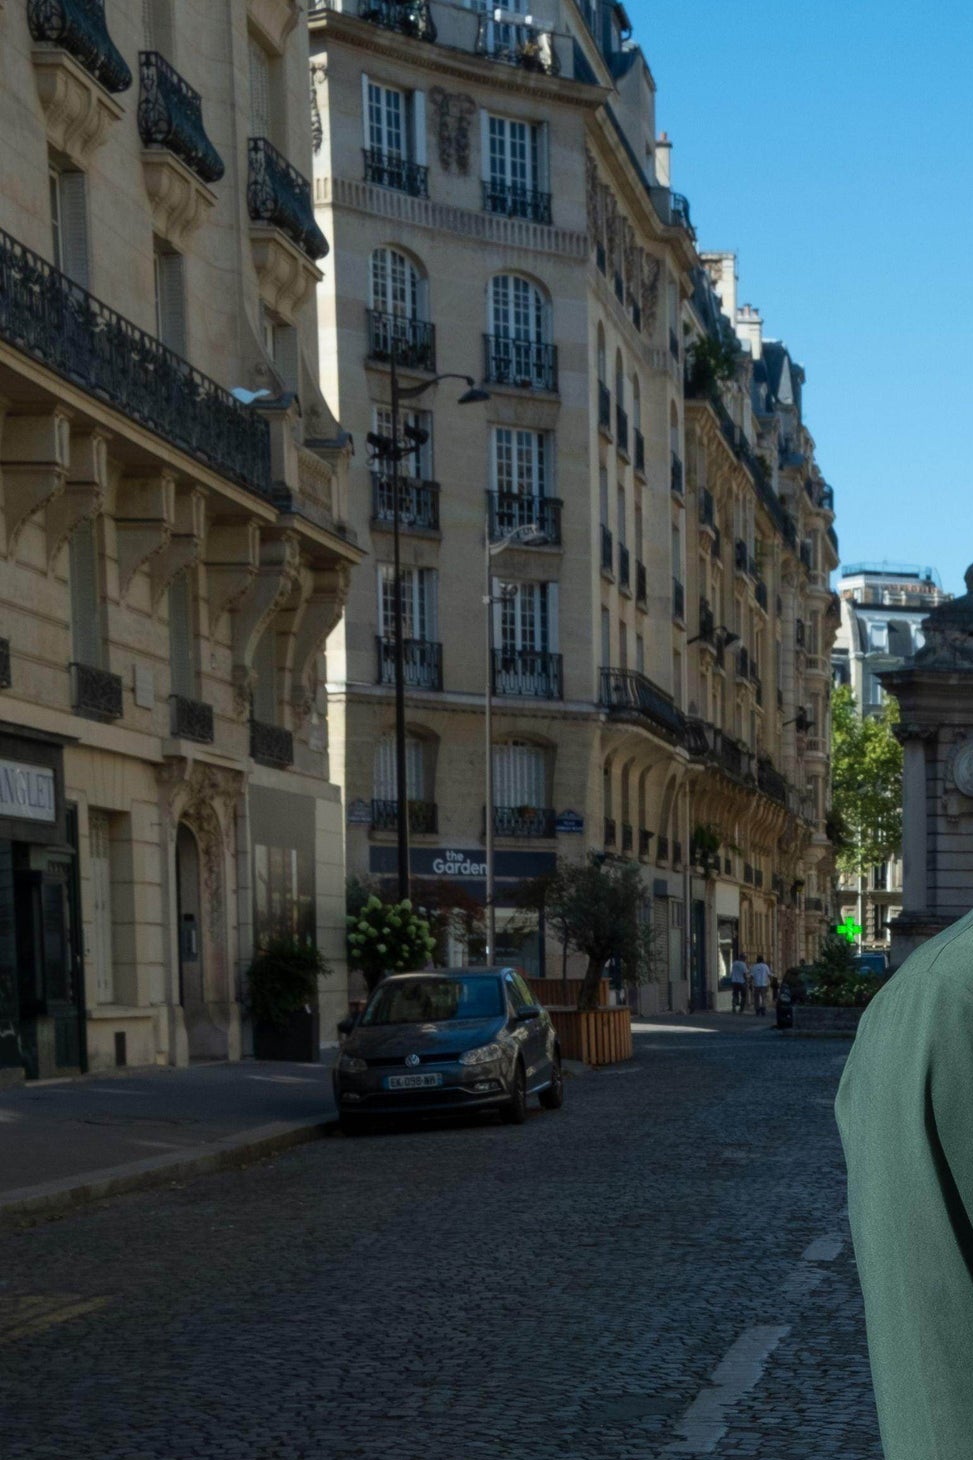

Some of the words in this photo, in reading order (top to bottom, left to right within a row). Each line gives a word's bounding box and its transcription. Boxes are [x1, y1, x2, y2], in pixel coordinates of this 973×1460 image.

[0, 766, 54, 809] NGLET
[446, 850, 464, 861] the
[433, 858, 488, 875] Garden
